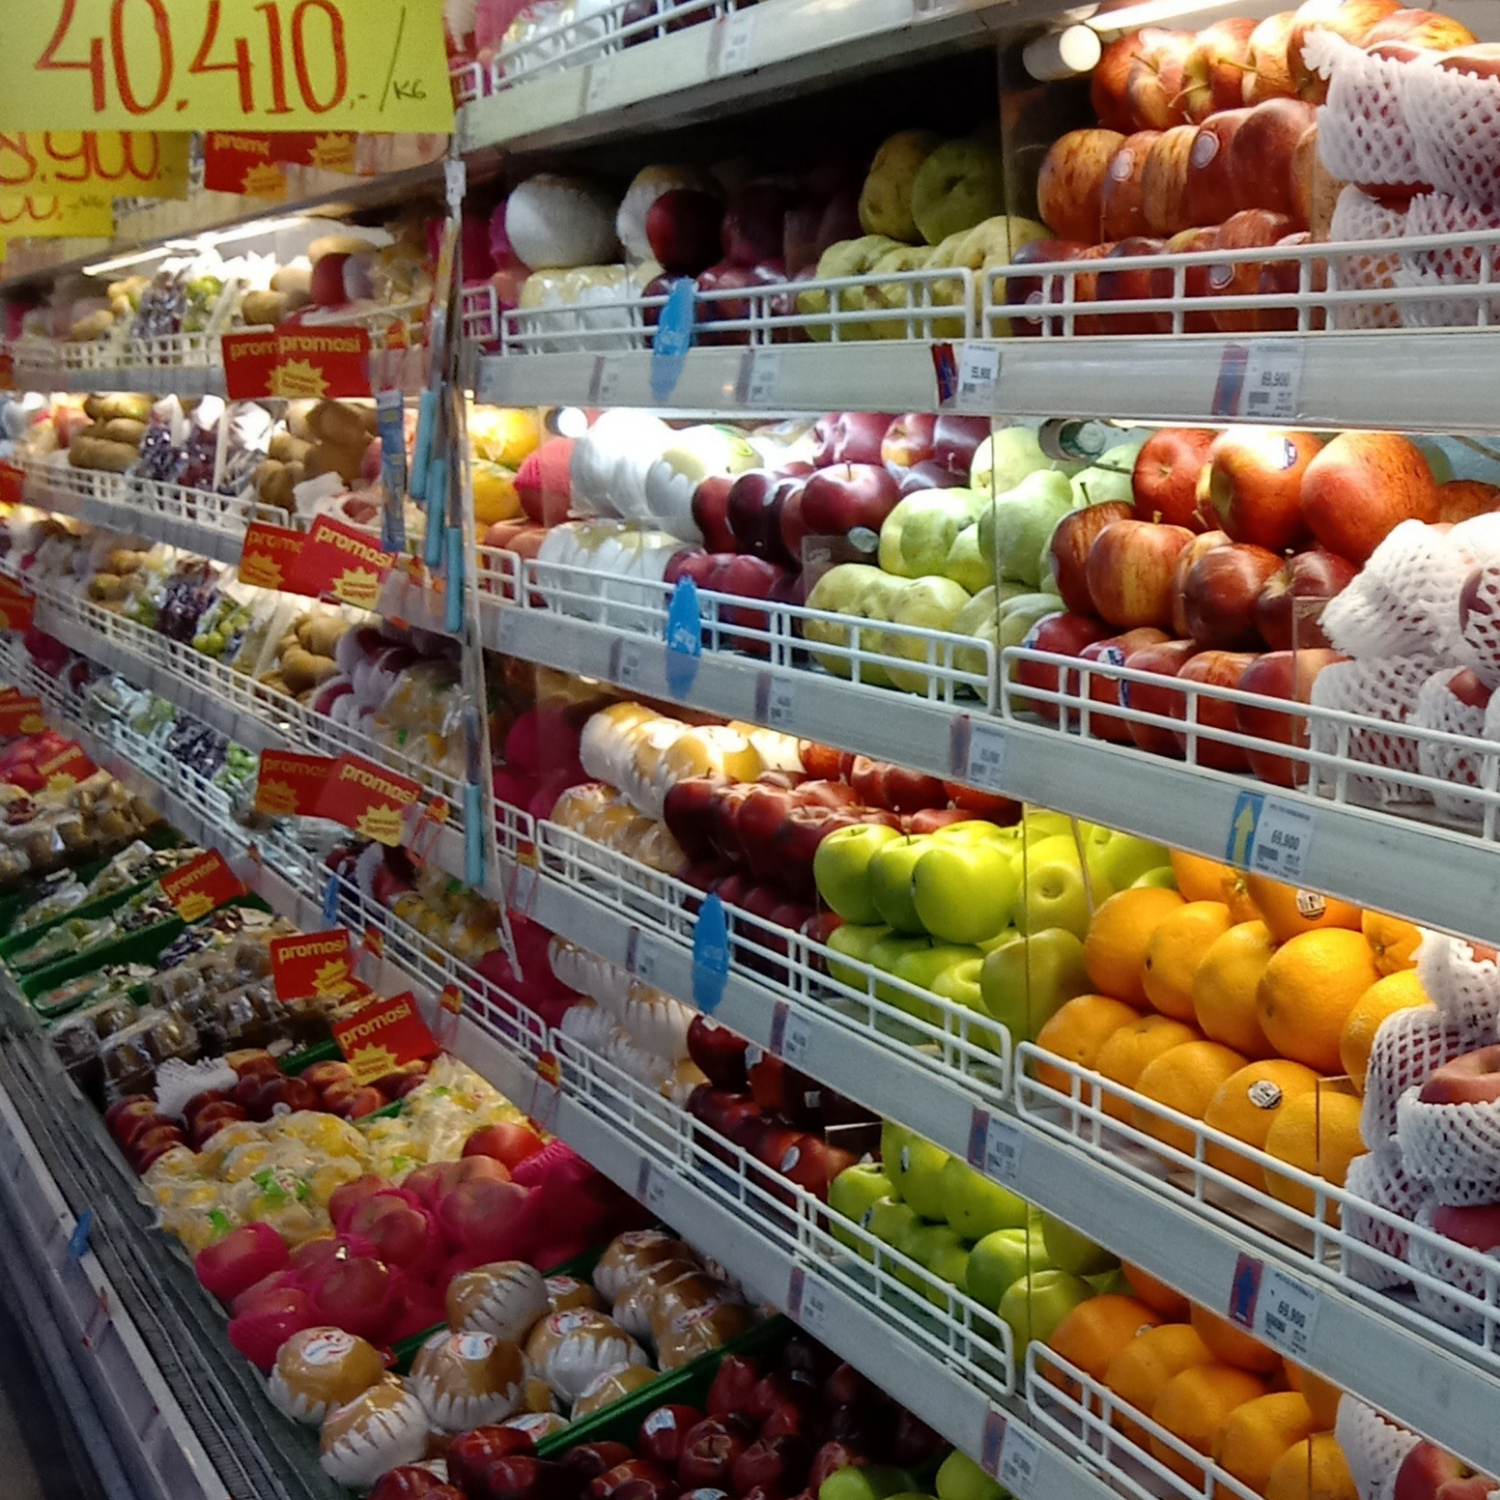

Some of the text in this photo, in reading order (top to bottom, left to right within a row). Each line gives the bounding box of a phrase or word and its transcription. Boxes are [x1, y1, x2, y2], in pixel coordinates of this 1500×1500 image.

[279, 332, 362, 355] promosi
[314, 524, 396, 569] promosi
[339, 763, 421, 804] promosi
[165, 855, 222, 897] promosi
[277, 935, 349, 962] promosi
[338, 1003, 412, 1047] promosi
